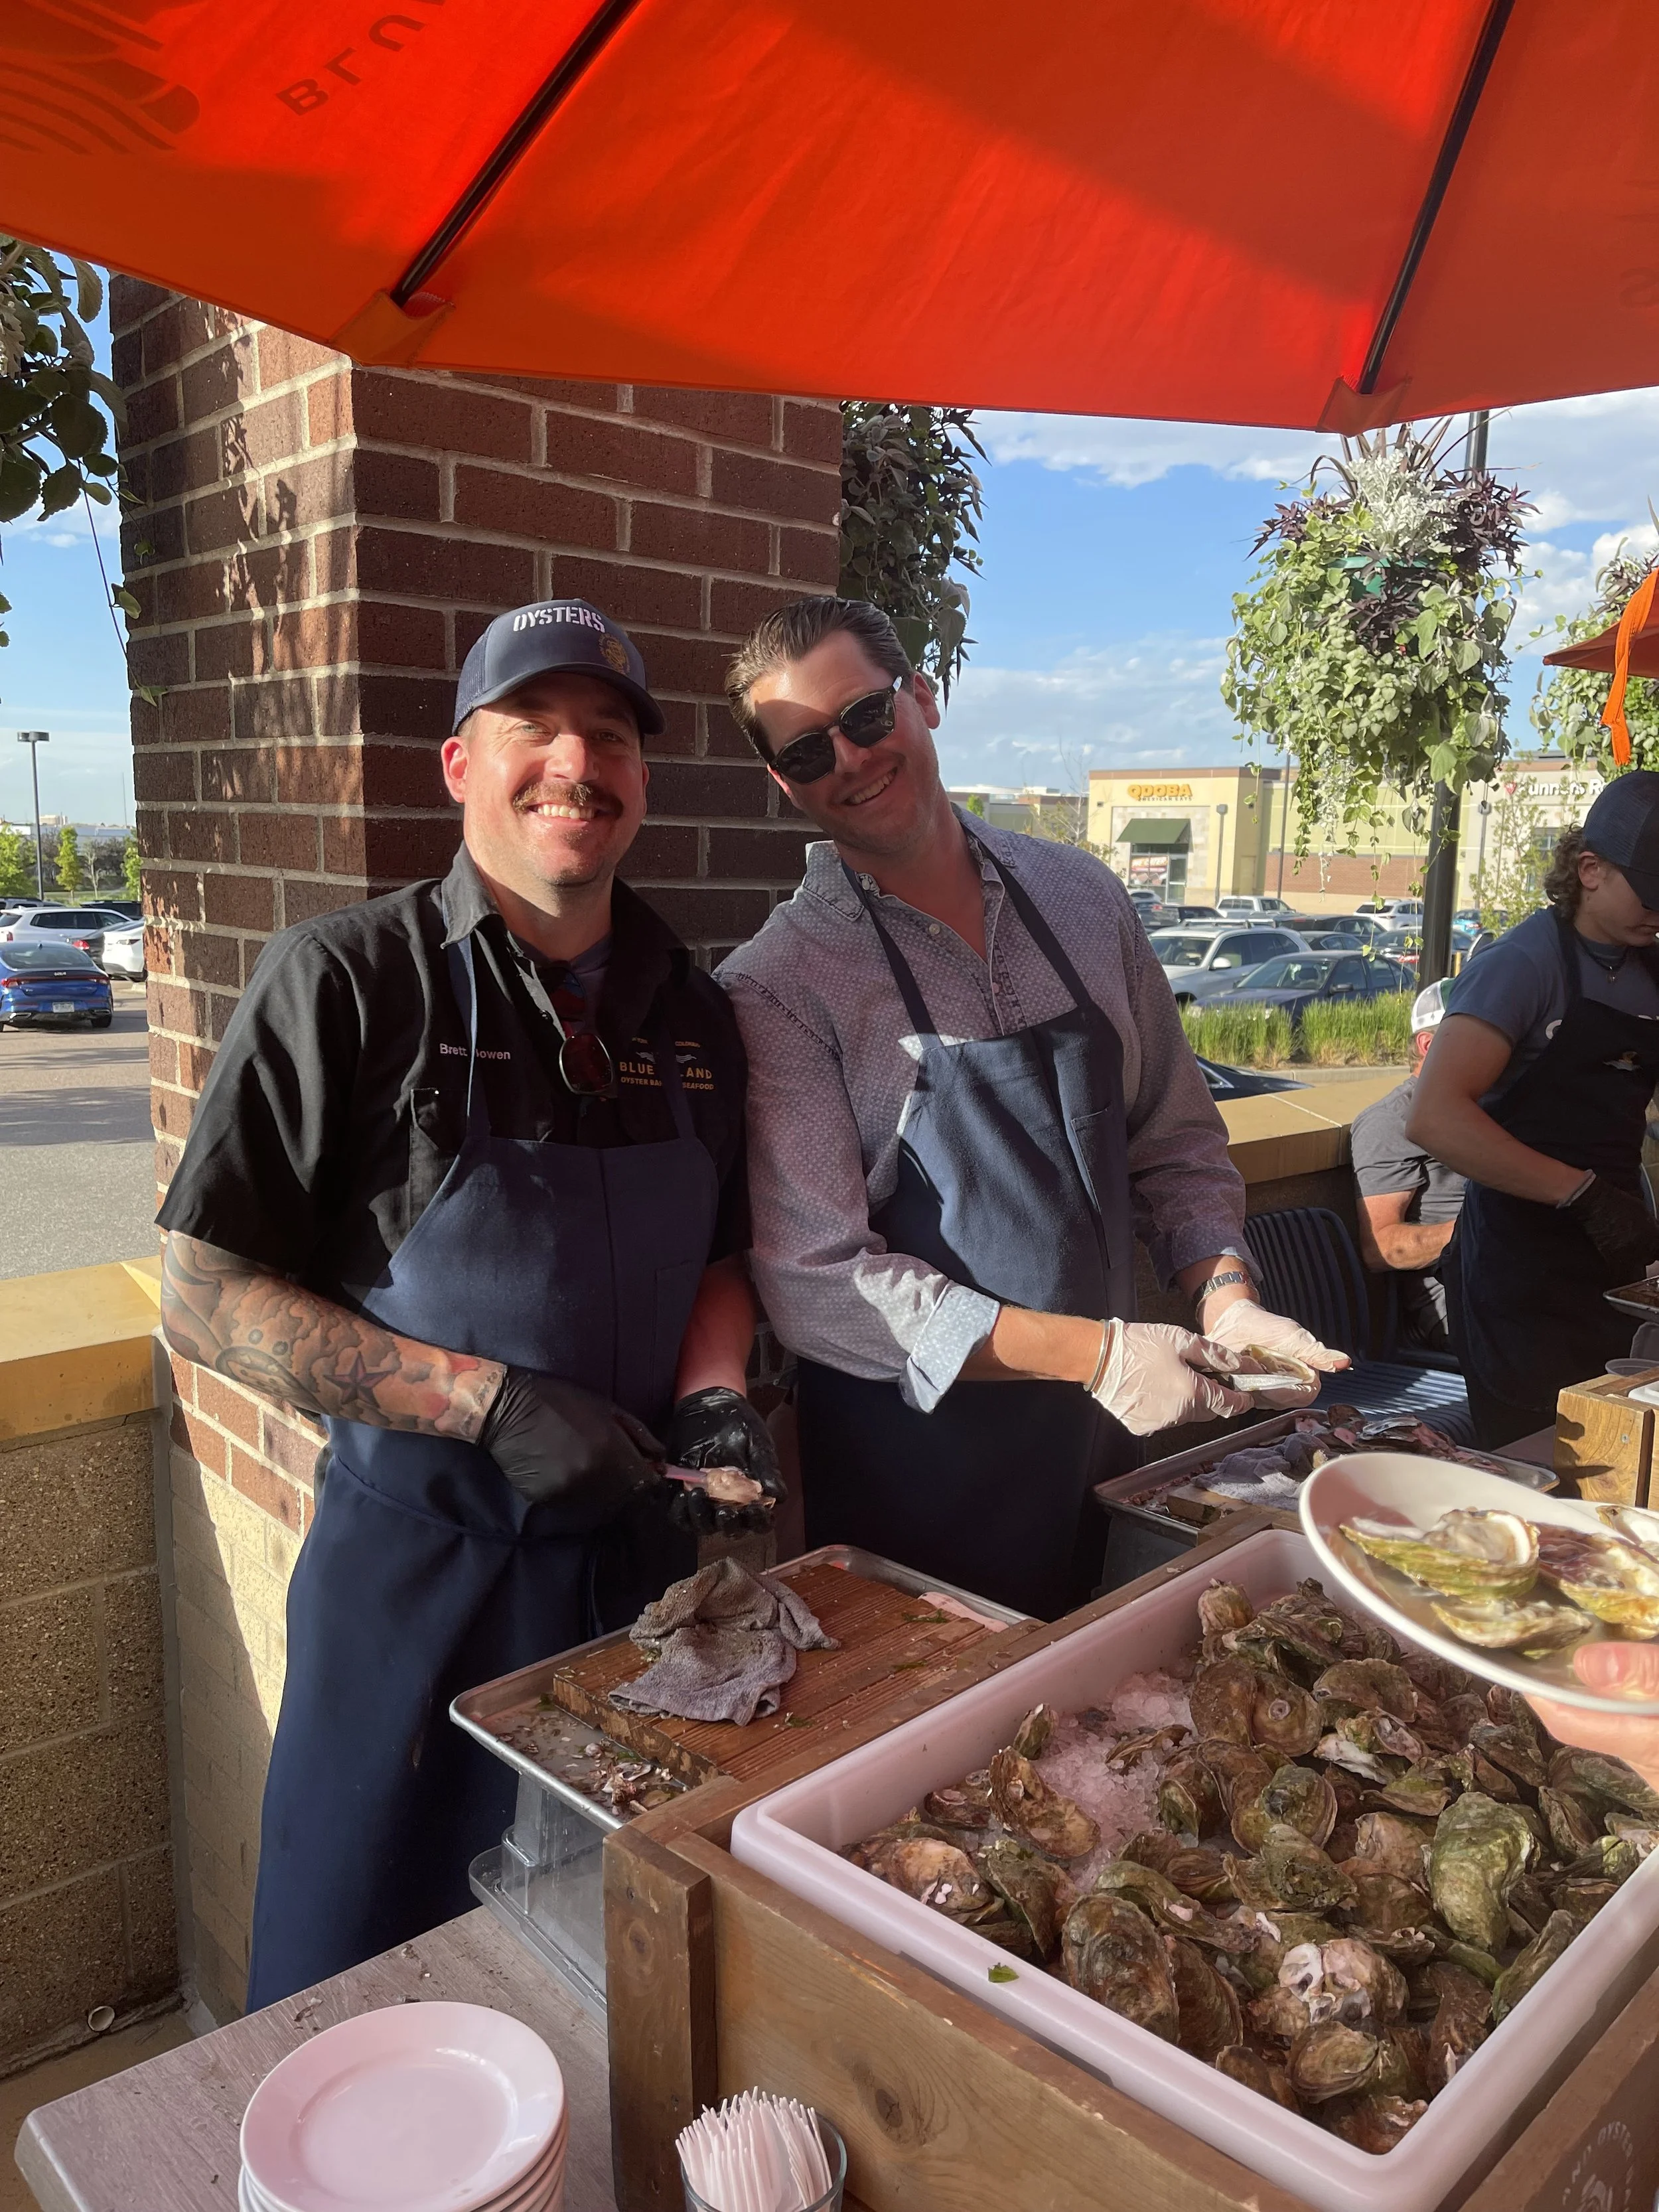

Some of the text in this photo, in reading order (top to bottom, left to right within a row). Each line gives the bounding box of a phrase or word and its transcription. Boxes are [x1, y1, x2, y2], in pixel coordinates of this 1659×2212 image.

[513, 606, 605, 633] OYSTERS
[1127, 784, 1192, 802] QDOBA
[439, 1043, 511, 1060] Brett owen
[619, 1061, 655, 1075] BLUE
[620, 1076, 648, 1086] OYSTER
[682, 1082, 715, 1090] SEAFOOD
